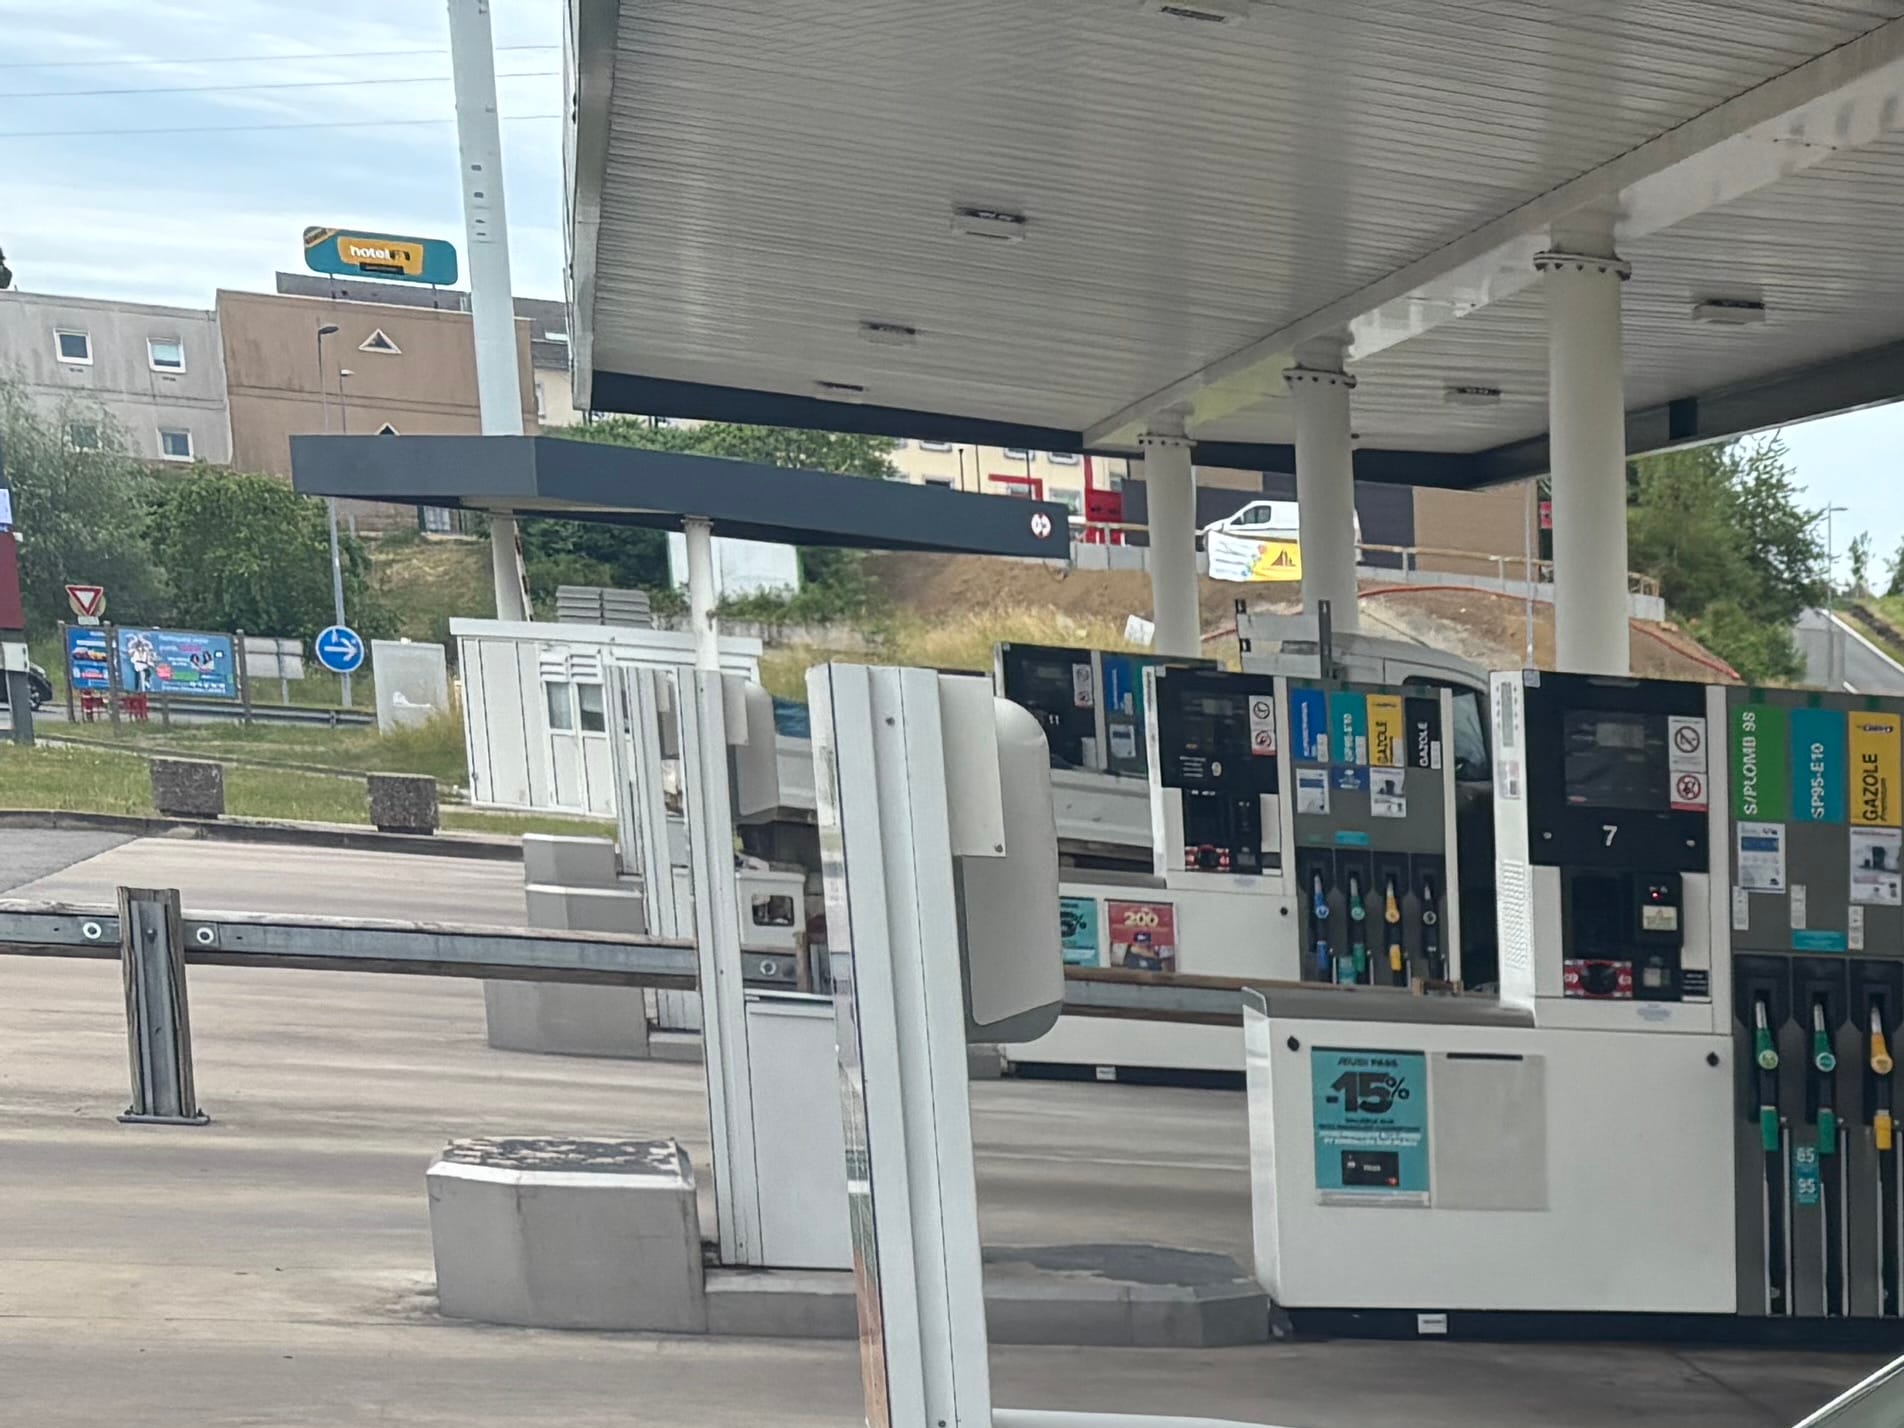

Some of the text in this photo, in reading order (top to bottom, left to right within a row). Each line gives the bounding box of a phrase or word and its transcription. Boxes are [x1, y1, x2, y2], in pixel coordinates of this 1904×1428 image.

[1417, 721, 1429, 767] GAZOLE
[1742, 736, 1758, 815] S/PLOMB
[1810, 742, 1825, 819] SP95-E10
[1862, 753, 1879, 822] GAZOLE
[1602, 825, 1618, 846] 7
[1123, 911, 1159, 928] 200
[1326, 1071, 1410, 1114] -15%
